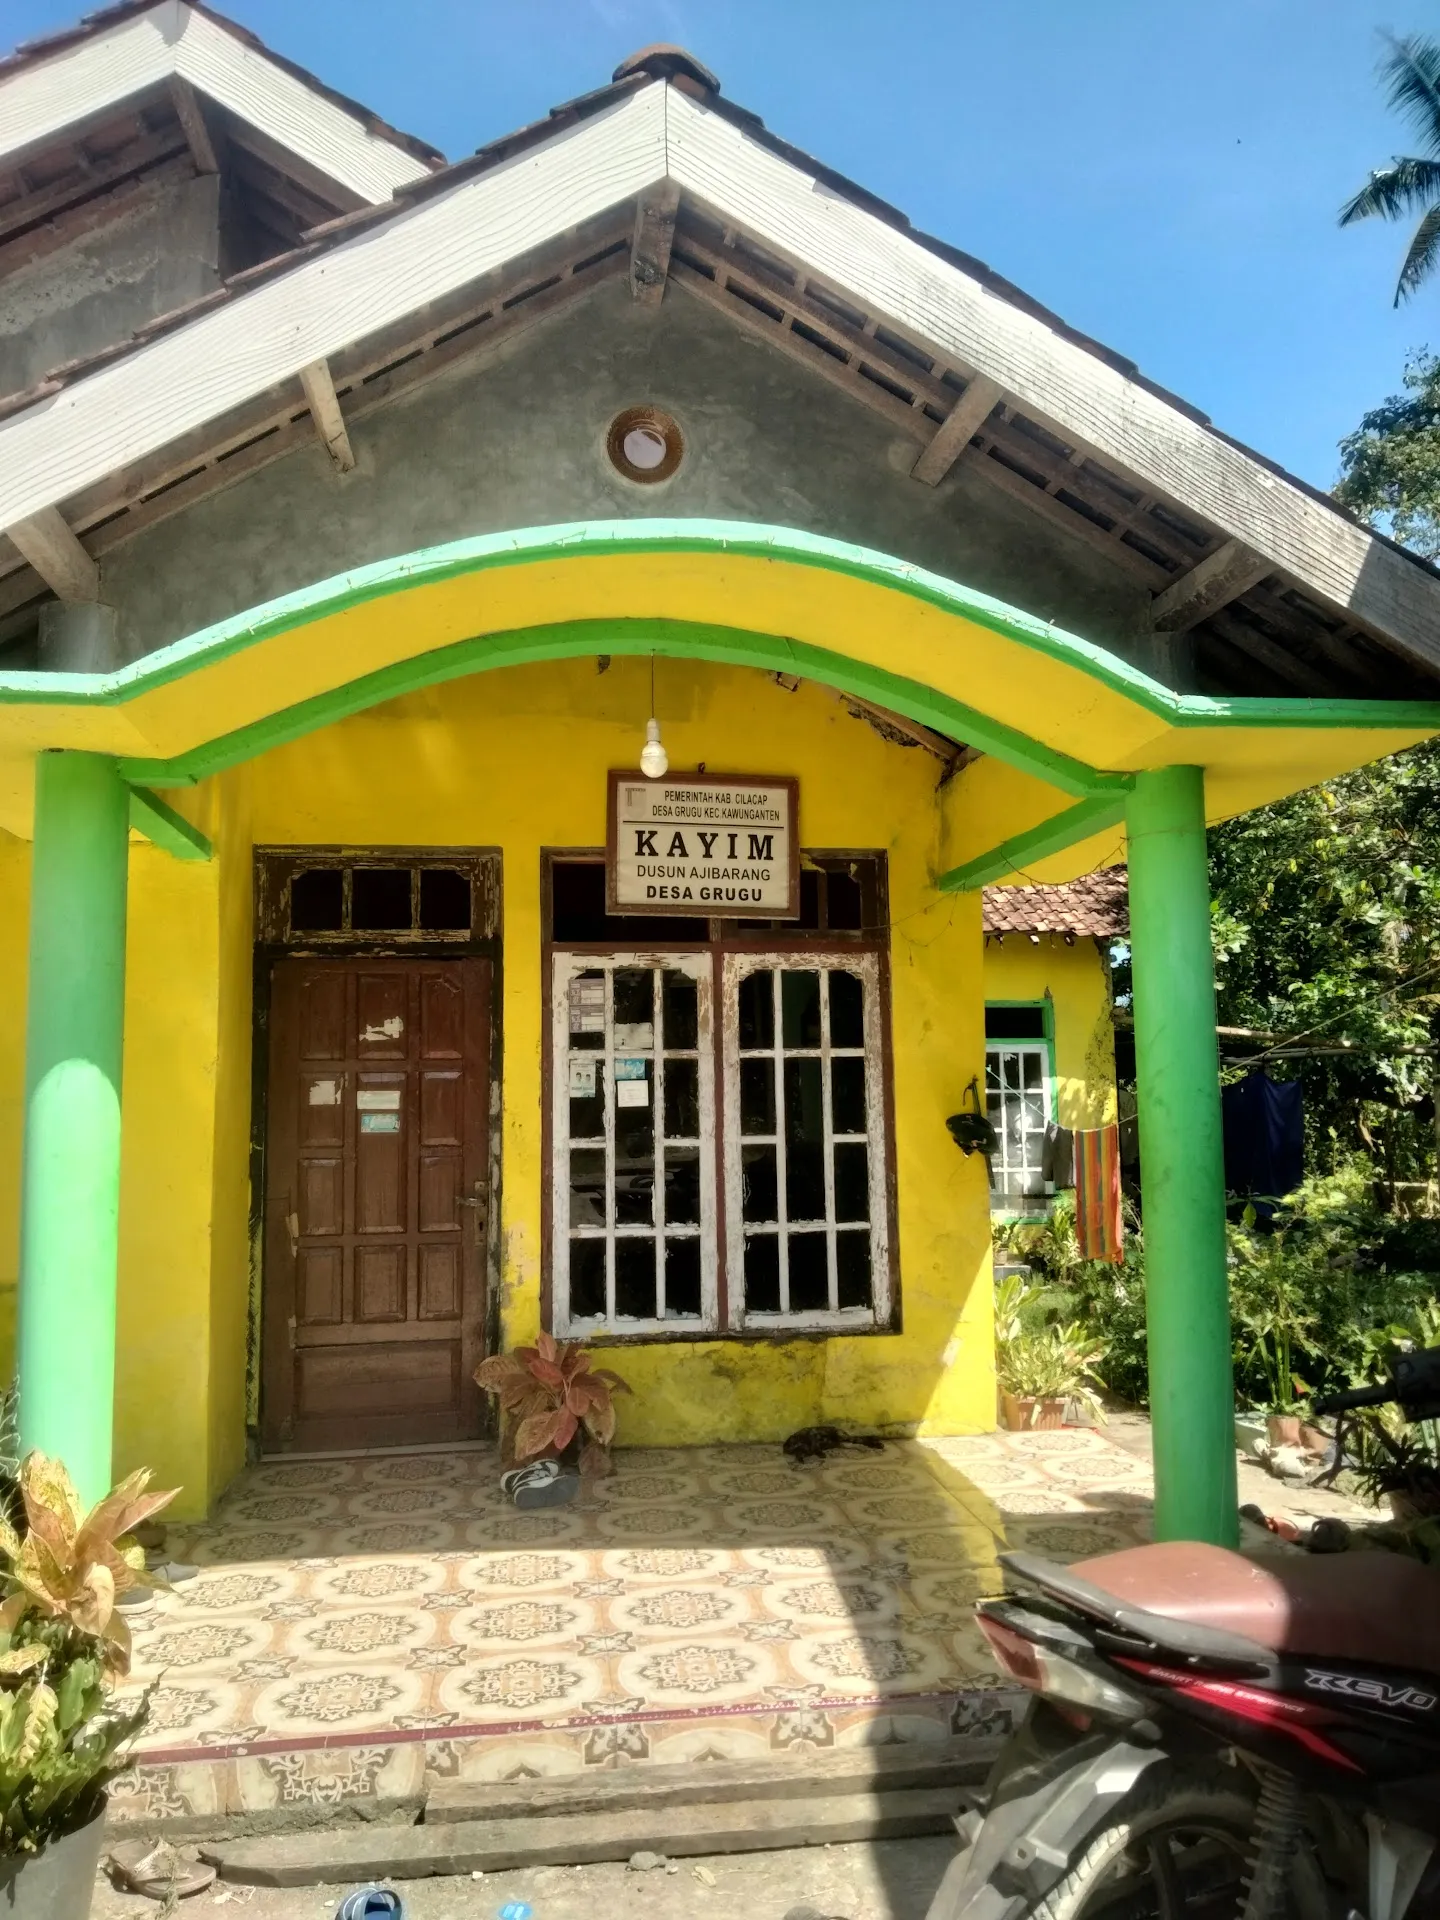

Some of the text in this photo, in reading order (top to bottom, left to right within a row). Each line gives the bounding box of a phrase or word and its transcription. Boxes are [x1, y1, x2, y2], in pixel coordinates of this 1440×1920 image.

[664, 790, 713, 804] PEMERINTAH
[735, 793, 768, 806] CILACAP
[652, 805, 673, 817] DESA
[674, 806, 702, 818] GRUGU
[722, 808, 780, 821] KAWUNGANTEN
[634, 830, 774, 860] KAYIM
[636, 864, 771, 881] DUSUN AJIBARANG
[646, 885, 762, 902] DESA GRUGU
